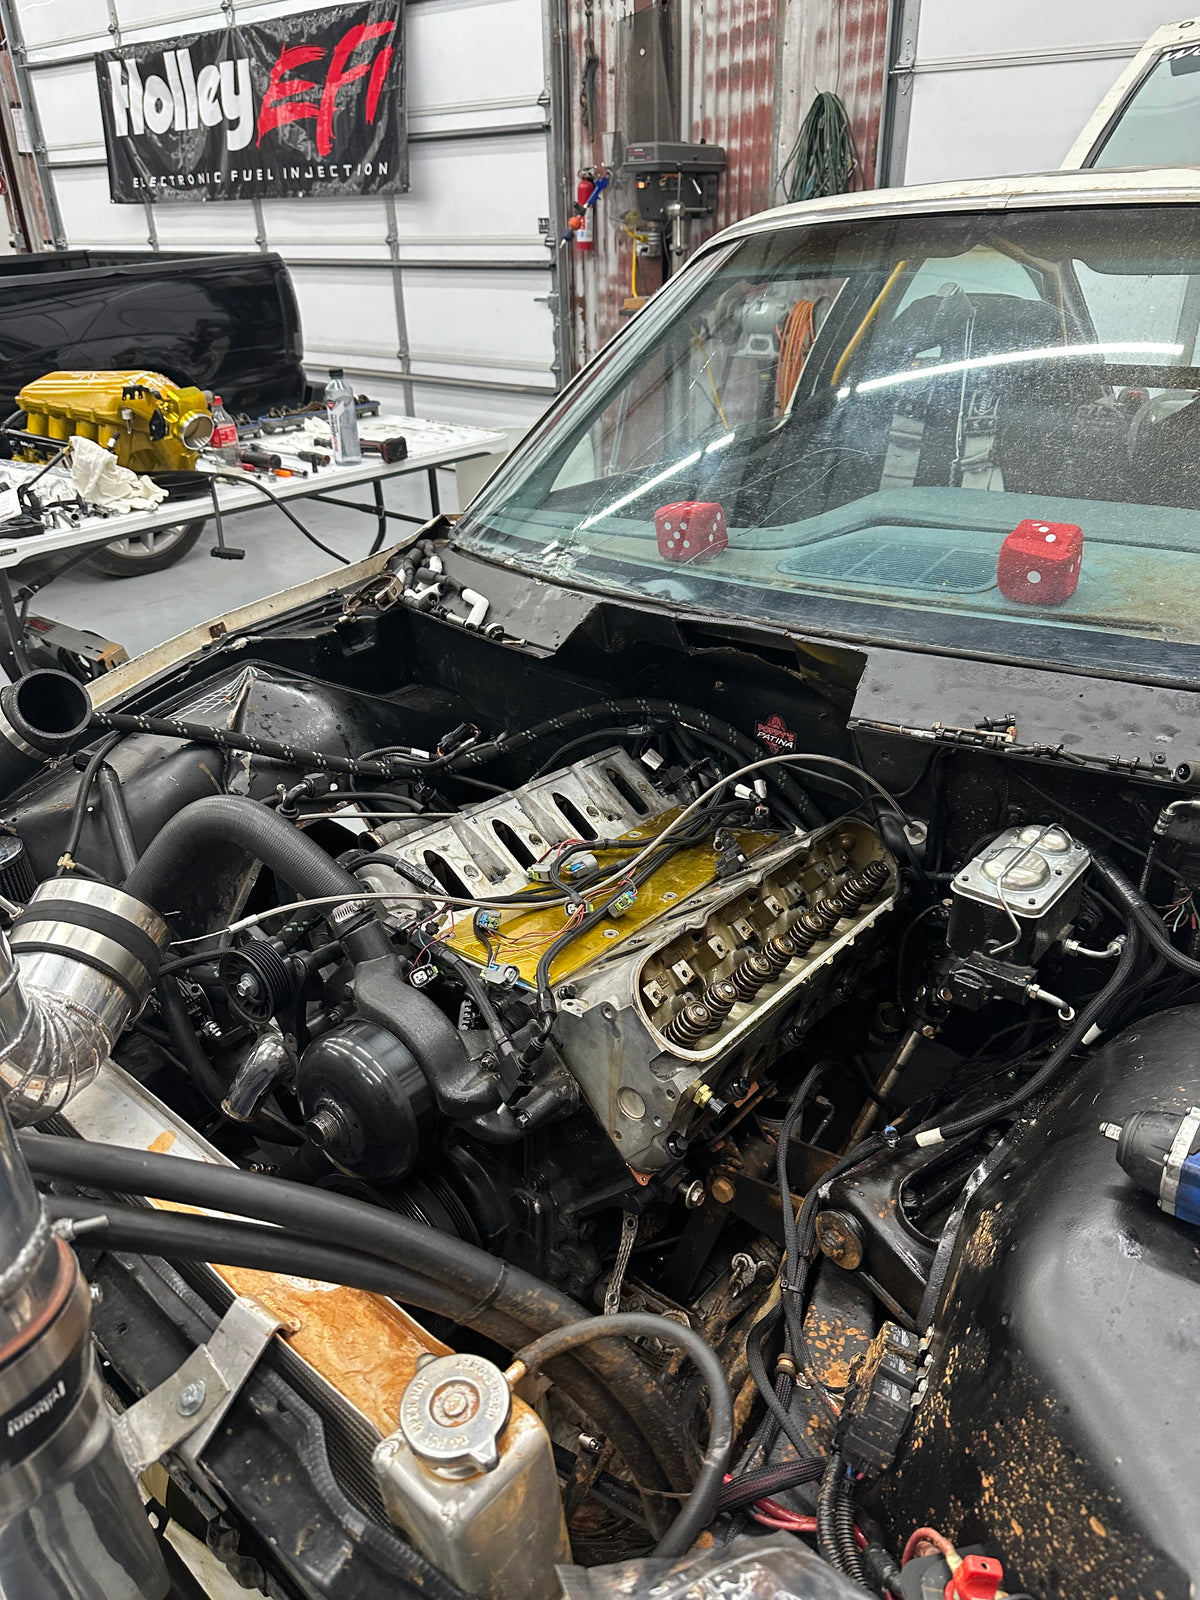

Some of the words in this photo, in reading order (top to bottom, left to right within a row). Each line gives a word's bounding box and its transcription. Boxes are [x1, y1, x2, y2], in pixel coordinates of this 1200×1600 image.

[107, 48, 254, 151] Holley
[256, 19, 396, 157] EFI
[132, 171, 221, 188] ELECTRONIC
[230, 168, 274, 182] FUEL
[283, 161, 389, 180] INJECTION
[757, 731, 794, 749] PATINA
